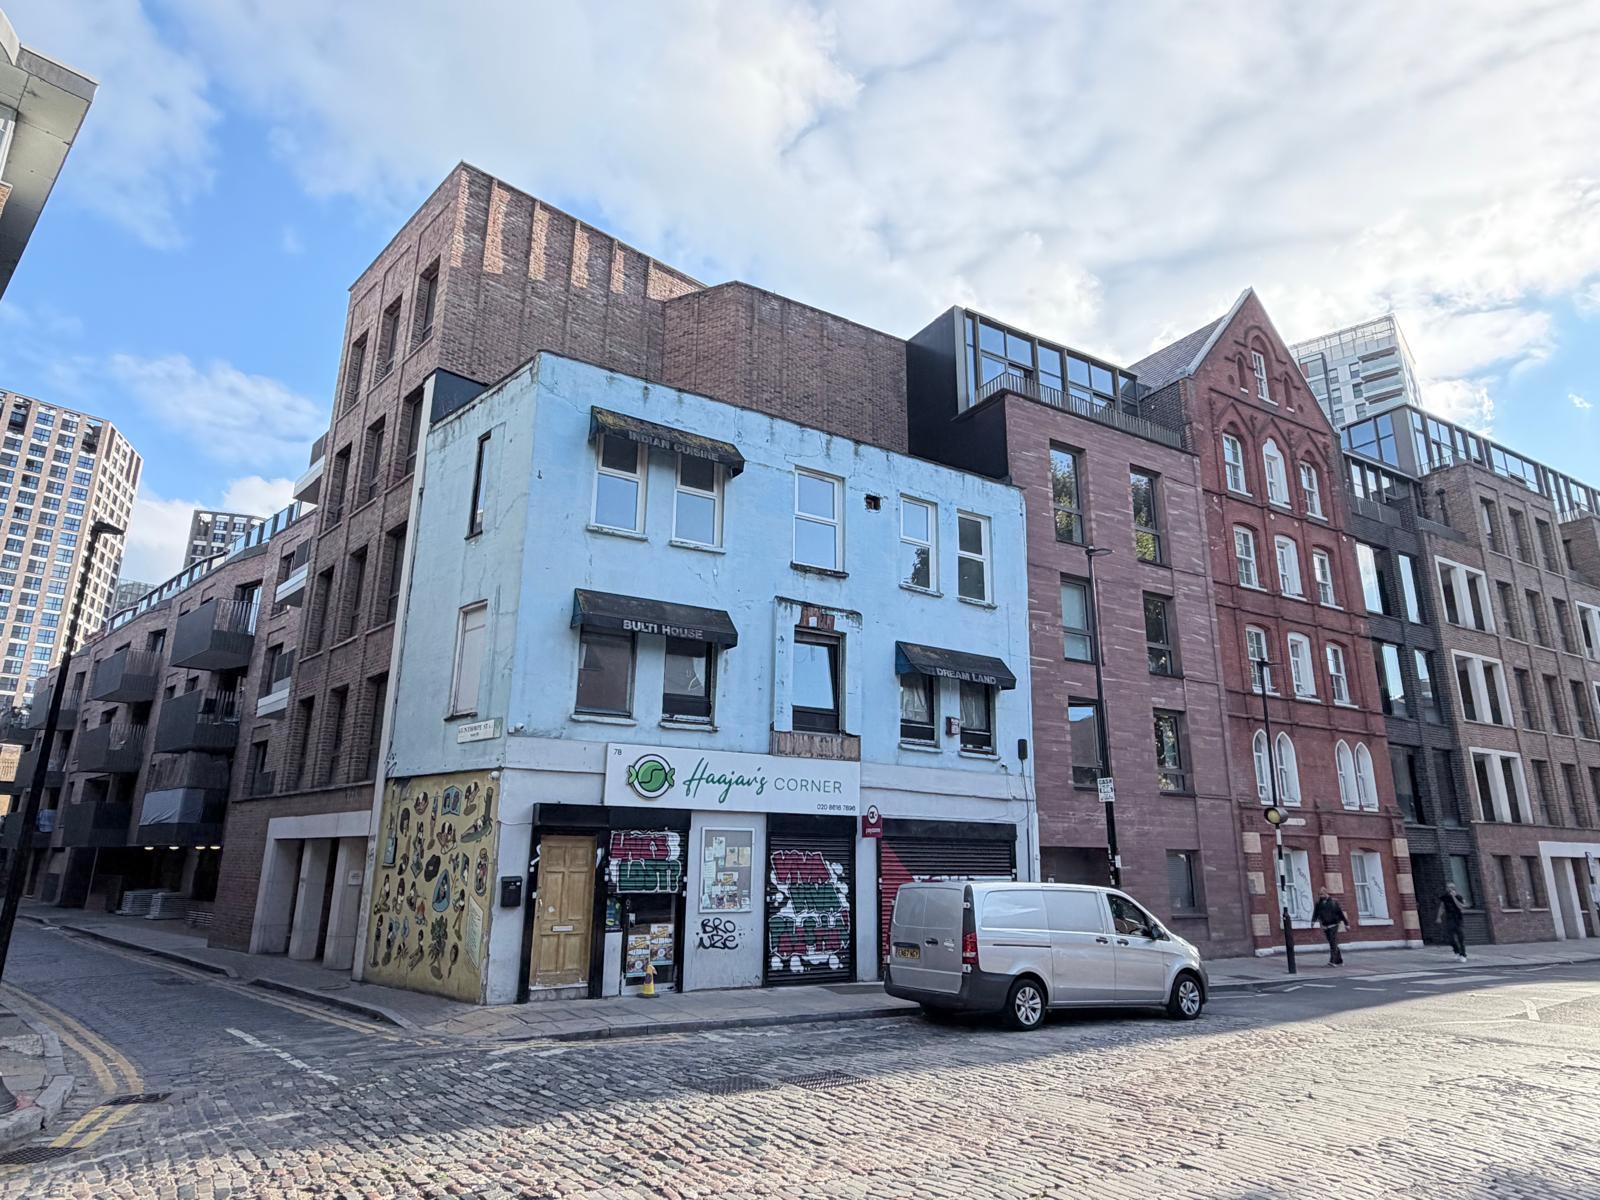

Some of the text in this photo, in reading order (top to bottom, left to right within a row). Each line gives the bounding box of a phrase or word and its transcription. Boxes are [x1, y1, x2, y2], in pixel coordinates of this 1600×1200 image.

[628, 430, 719, 462] INDIAN CUISINE
[623, 619, 703, 640] BULTI HOUSE
[936, 667, 997, 685] DREAM LAND
[774, 777, 842, 794] CORNER
